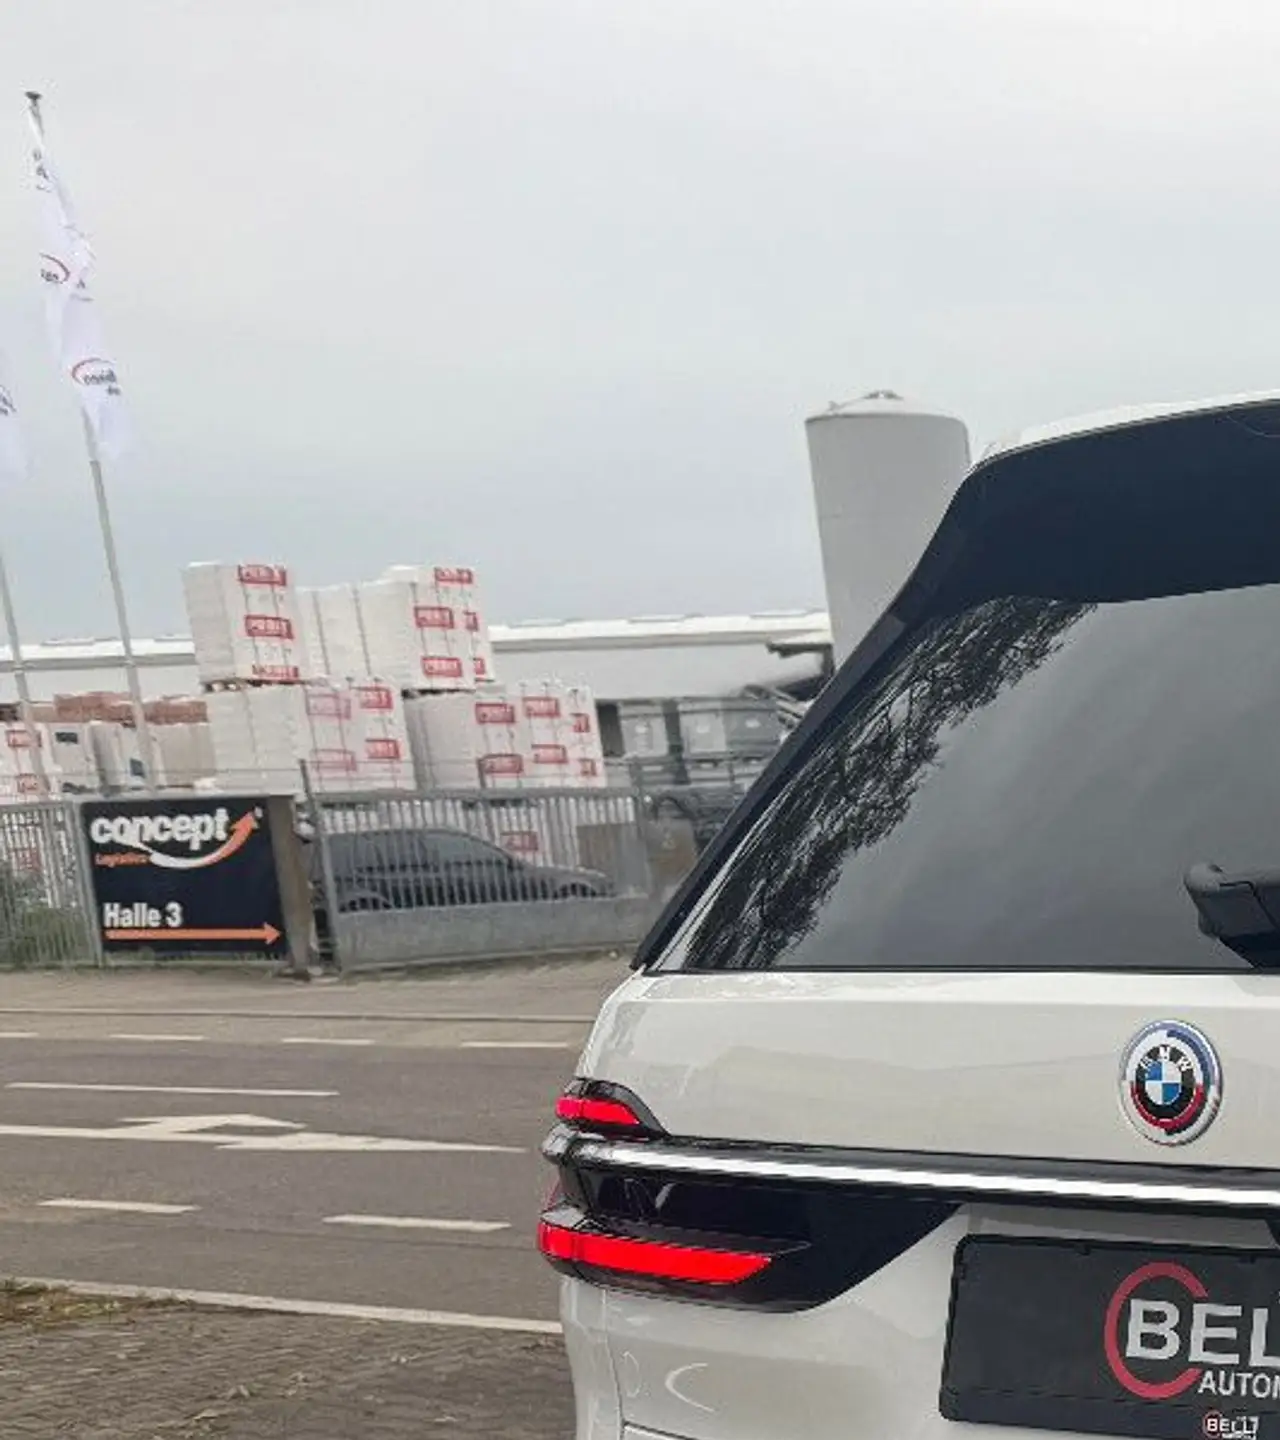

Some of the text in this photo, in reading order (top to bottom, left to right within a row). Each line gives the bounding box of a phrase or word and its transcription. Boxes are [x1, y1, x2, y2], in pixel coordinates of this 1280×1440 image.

[91, 807, 229, 850] concept
[103, 901, 183, 928] Halle 3
[1140, 1045, 1193, 1072] BMW
